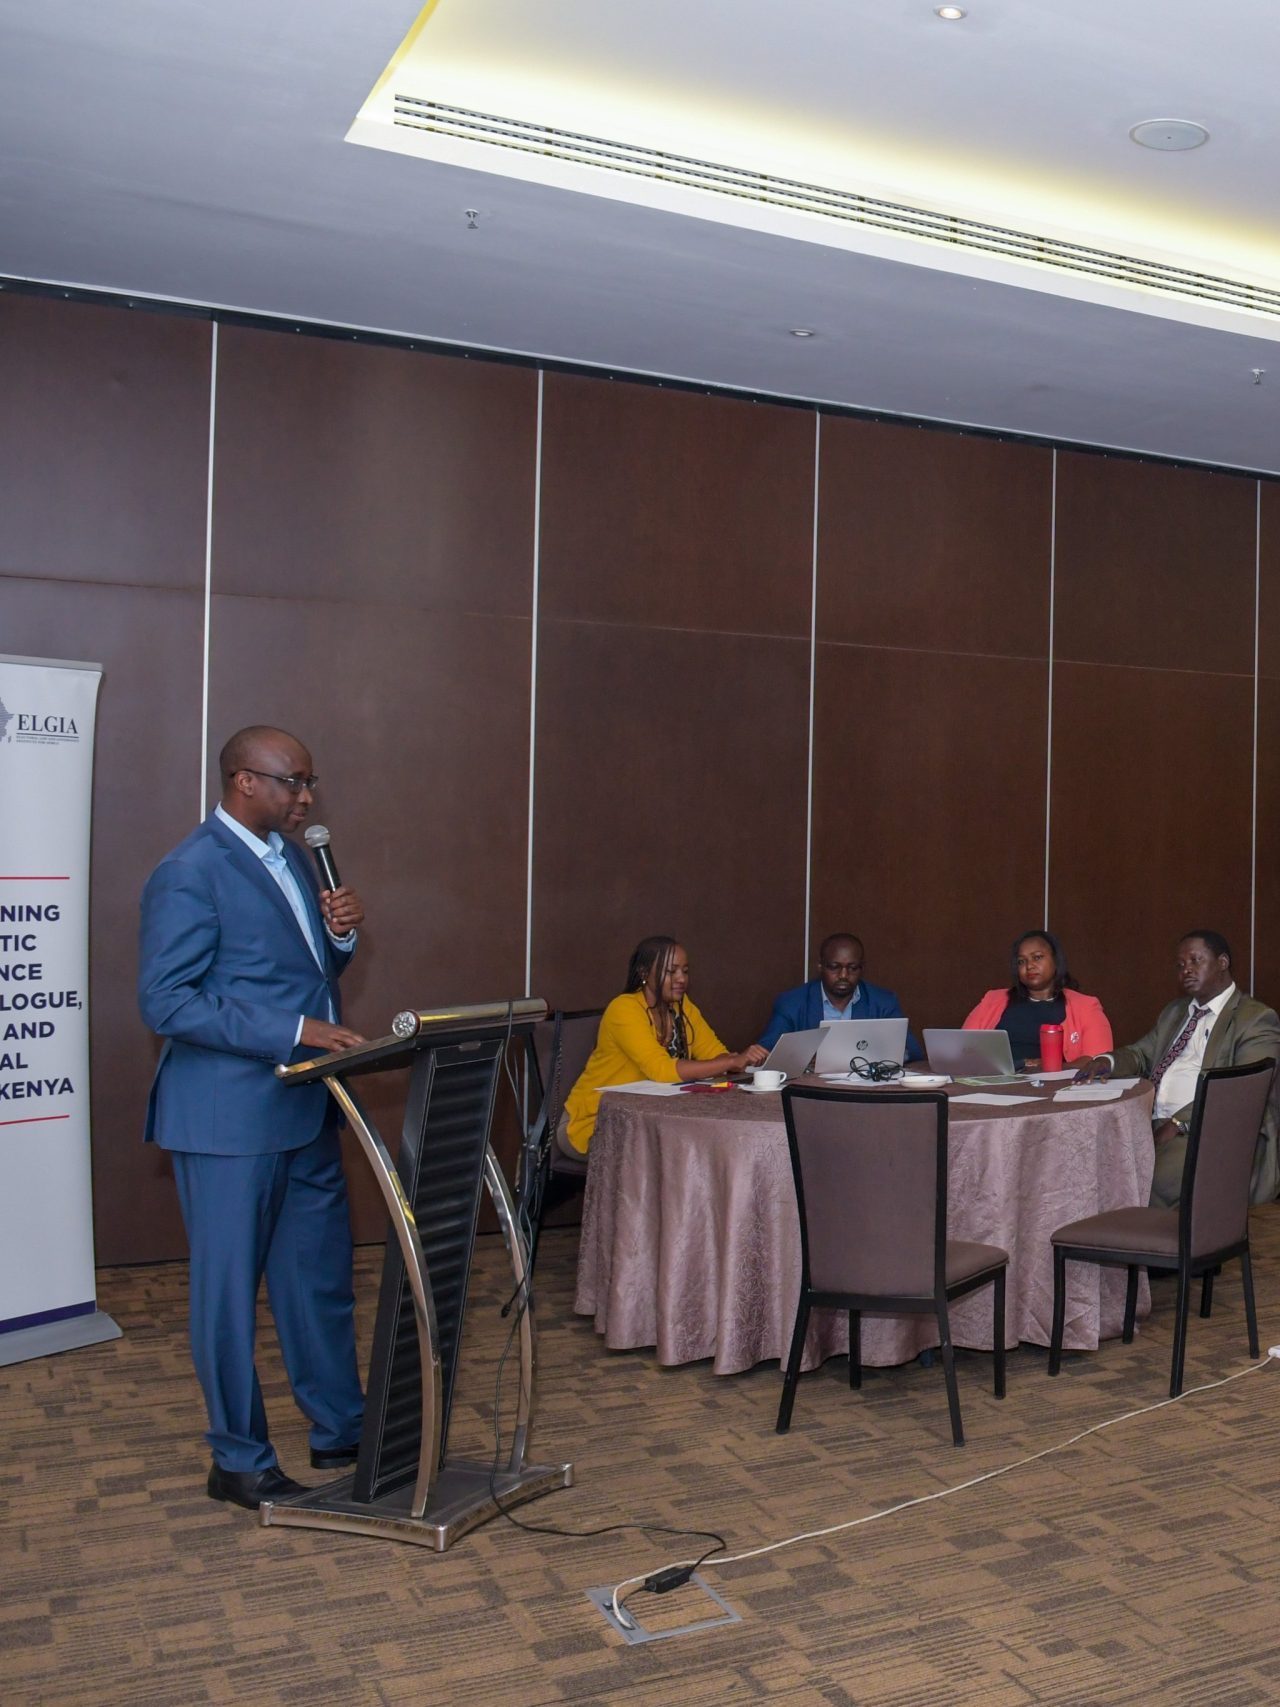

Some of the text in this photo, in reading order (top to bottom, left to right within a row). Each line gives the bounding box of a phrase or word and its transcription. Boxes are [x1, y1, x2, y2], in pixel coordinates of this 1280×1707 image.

[17, 713, 78, 734] ELGIA
[0, 904, 60, 922] NING
[3, 1021, 55, 1041] AND
